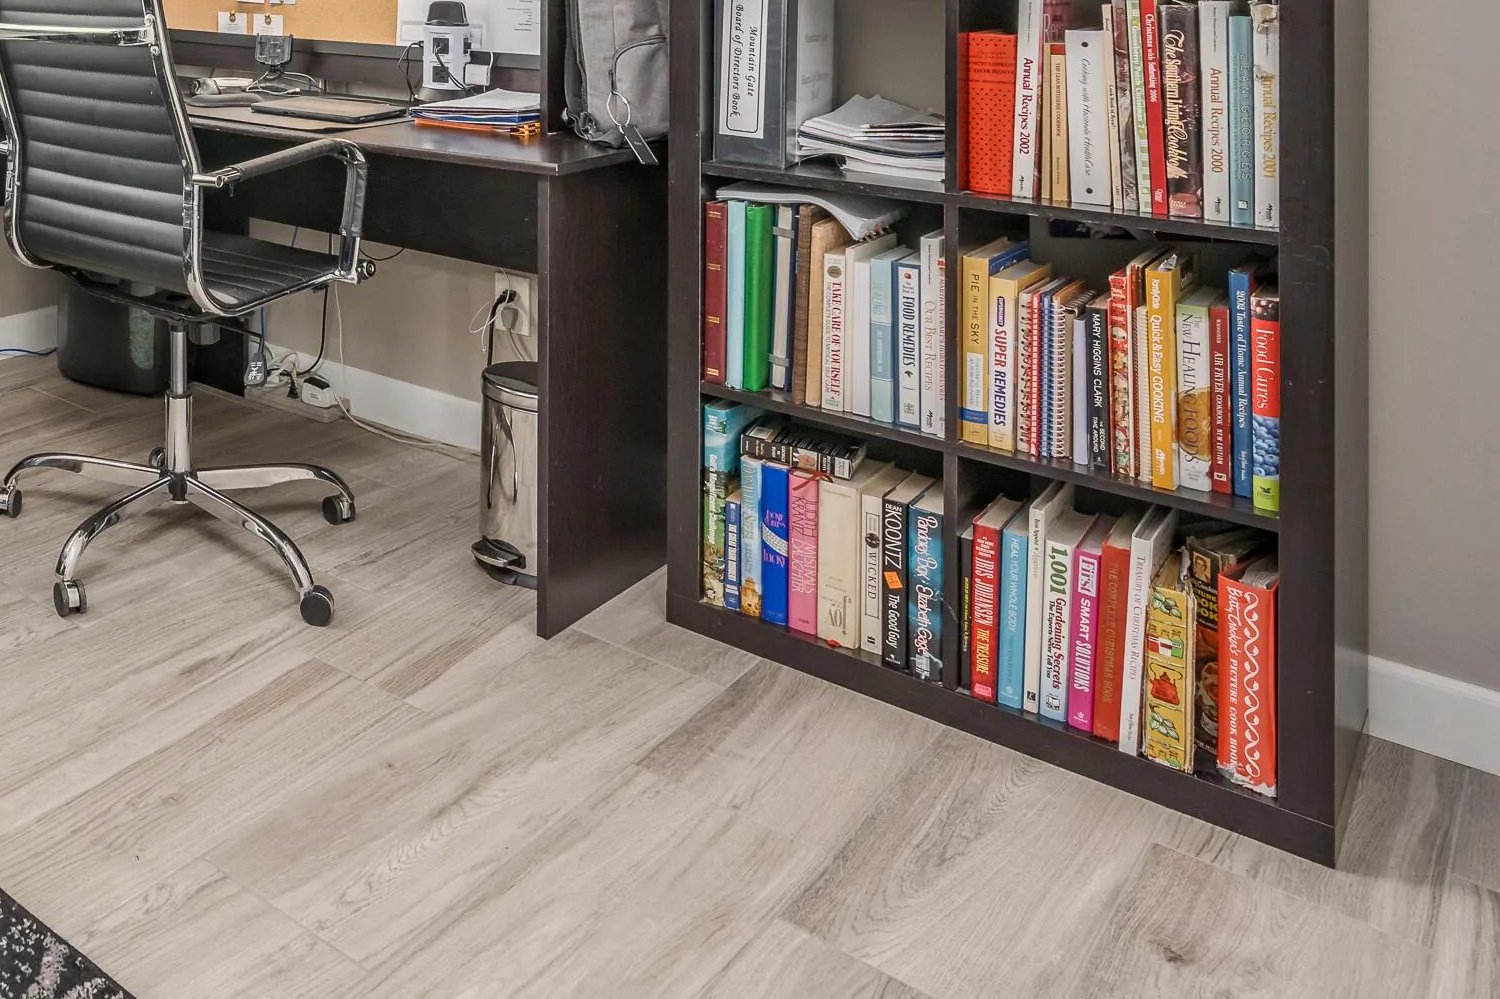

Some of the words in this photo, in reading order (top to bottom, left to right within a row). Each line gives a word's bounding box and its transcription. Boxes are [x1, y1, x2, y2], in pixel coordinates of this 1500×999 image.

[735, 4, 744, 34] Board
[732, 34, 743, 46] of
[748, 26, 757, 72] Mountain
[1164, 29, 1185, 59] The
[732, 47, 742, 90] Directors
[1022, 57, 1034, 91] Annual
[1165, 59, 1181, 98] Southern
[745, 75, 756, 97] Gate
[1262, 72, 1276, 108] Annual
[729, 93, 740, 117] Book
[1018, 94, 1034, 130] Recipes
[1165, 99, 1183, 125] Living
[1019, 131, 1031, 155] 2002
[1260, 112, 1277, 152] Recipes
[1263, 153, 1277, 179] 2001
[831, 281, 843, 306] TAKE
[970, 273, 980, 292] PIE
[902, 296, 915, 320] FOOD
[924, 300, 936, 324] OUR
[971, 295, 978, 304] IN
[971, 306, 979, 321] THE
[831, 306, 841, 332] CARE
[970, 323, 980, 345] SKY
[1092, 313, 1101, 338] MARY
[1150, 314, 1162, 342] Quick
[1181, 312, 1194, 339] NEW
[831, 333, 841, 346] OF
[902, 322, 915, 367] REMEDIES
[925, 327, 936, 351] BEST
[994, 328, 1007, 367] SUPER
[1153, 343, 1162, 351] &
[1255, 328, 1275, 363] Food
[830, 348, 841, 396] YOURSELF
[924, 353, 936, 392] RECIPES
[1093, 340, 1101, 376] HIGGINS
[1151, 351, 1162, 374] Easy
[1182, 340, 1201, 405] HEALING
[993, 370, 1006, 427] REMEDIES
[1093, 378, 1103, 408] CLARK
[1153, 375, 1165, 423] COOKING
[1256, 367, 1274, 409] Cures
[1098, 428, 1106, 451] SECOND
[1184, 409, 1199, 463] FOODS
[709, 454, 718, 472] Golf's
[709, 472, 718, 512] Magnificent
[886, 503, 902, 511] DEAN
[708, 513, 718, 544] Challenge
[792, 495, 804, 537] KRANTZ
[804, 495, 817, 538] JUDITH
[884, 509, 902, 570] KOONTZ
[1010, 538, 1019, 558] HEAL
[792, 538, 804, 593] DAUGHTER
[867, 552, 877, 600] WICKED
[917, 556, 938, 581] Box
[974, 557, 994, 579] IRIS
[1009, 559, 1019, 582] YOUR
[1048, 546, 1068, 596] 1,001
[1079, 559, 1095, 594] First
[888, 594, 900, 609] The
[915, 584, 934, 627] Elizabeth
[974, 578, 993, 627] JOHANSEN
[1008, 582, 1018, 609] WHOLE
[1225, 586, 1243, 613] Betty
[888, 609, 900, 630] Good
[1007, 610, 1017, 633] BODY
[1046, 612, 1054, 636] Experts
[1052, 598, 1067, 649] Gardening
[1078, 598, 1091, 640] SMART
[886, 631, 899, 649] Guy
[914, 627, 932, 655] Gage
[976, 628, 989, 642] THE
[1227, 613, 1241, 656] Crocker's
[976, 641, 989, 675] TREASURE
[1051, 652, 1064, 689] Secrets
[1073, 640, 1092, 693] SOLUTIONS
[1229, 658, 1238, 704] PICTURE
[1229, 706, 1238, 736] COOK
[1229, 737, 1238, 766] BOOK
